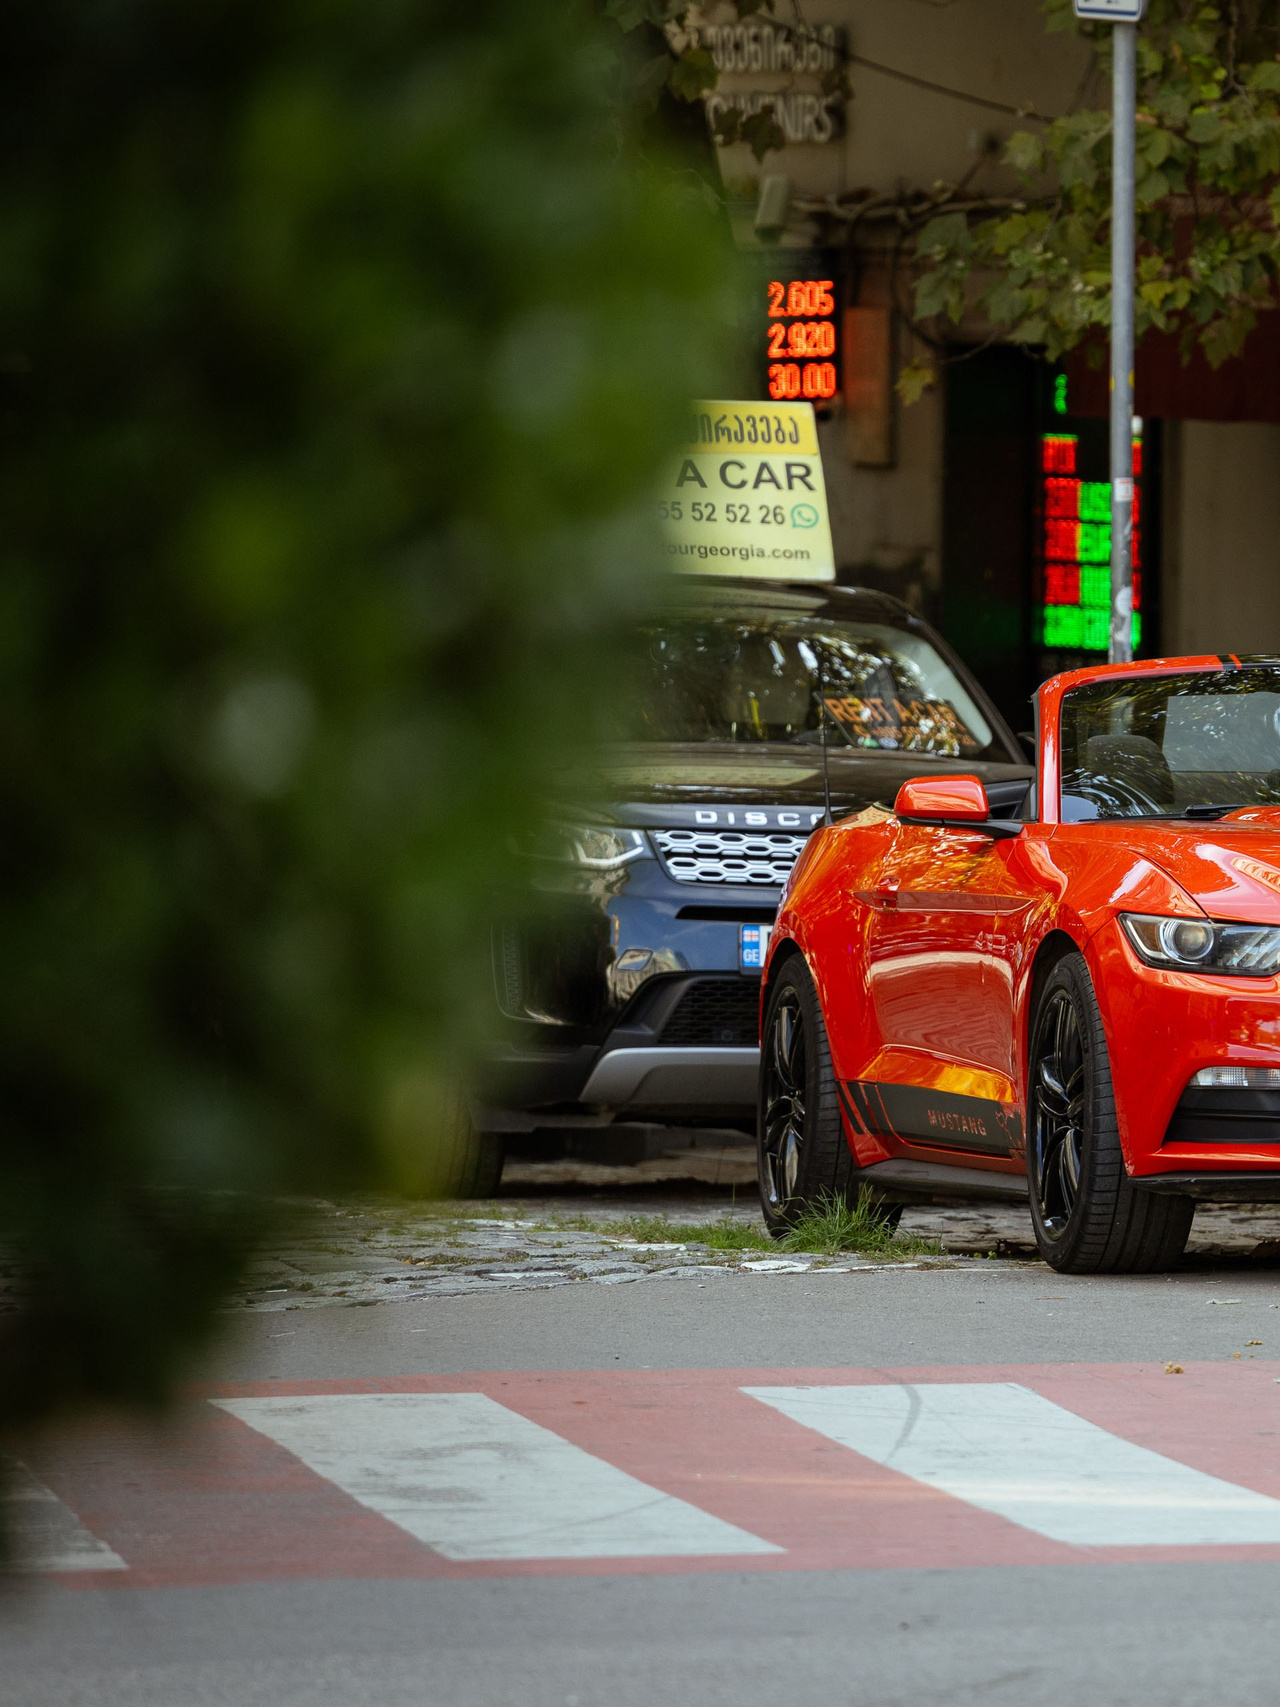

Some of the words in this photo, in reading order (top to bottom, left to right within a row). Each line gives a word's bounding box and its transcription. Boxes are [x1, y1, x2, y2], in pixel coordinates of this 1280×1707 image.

[767, 280, 835, 317] 2.605
[767, 321, 836, 358] 2.920
[675, 458, 708, 489] A
[719, 459, 817, 492] CAR
[691, 502, 718, 523] 52
[725, 503, 751, 525] 52
[758, 504, 786, 526] 26
[743, 948, 760, 964] GE
[927, 1108, 988, 1137] MUSTANG
